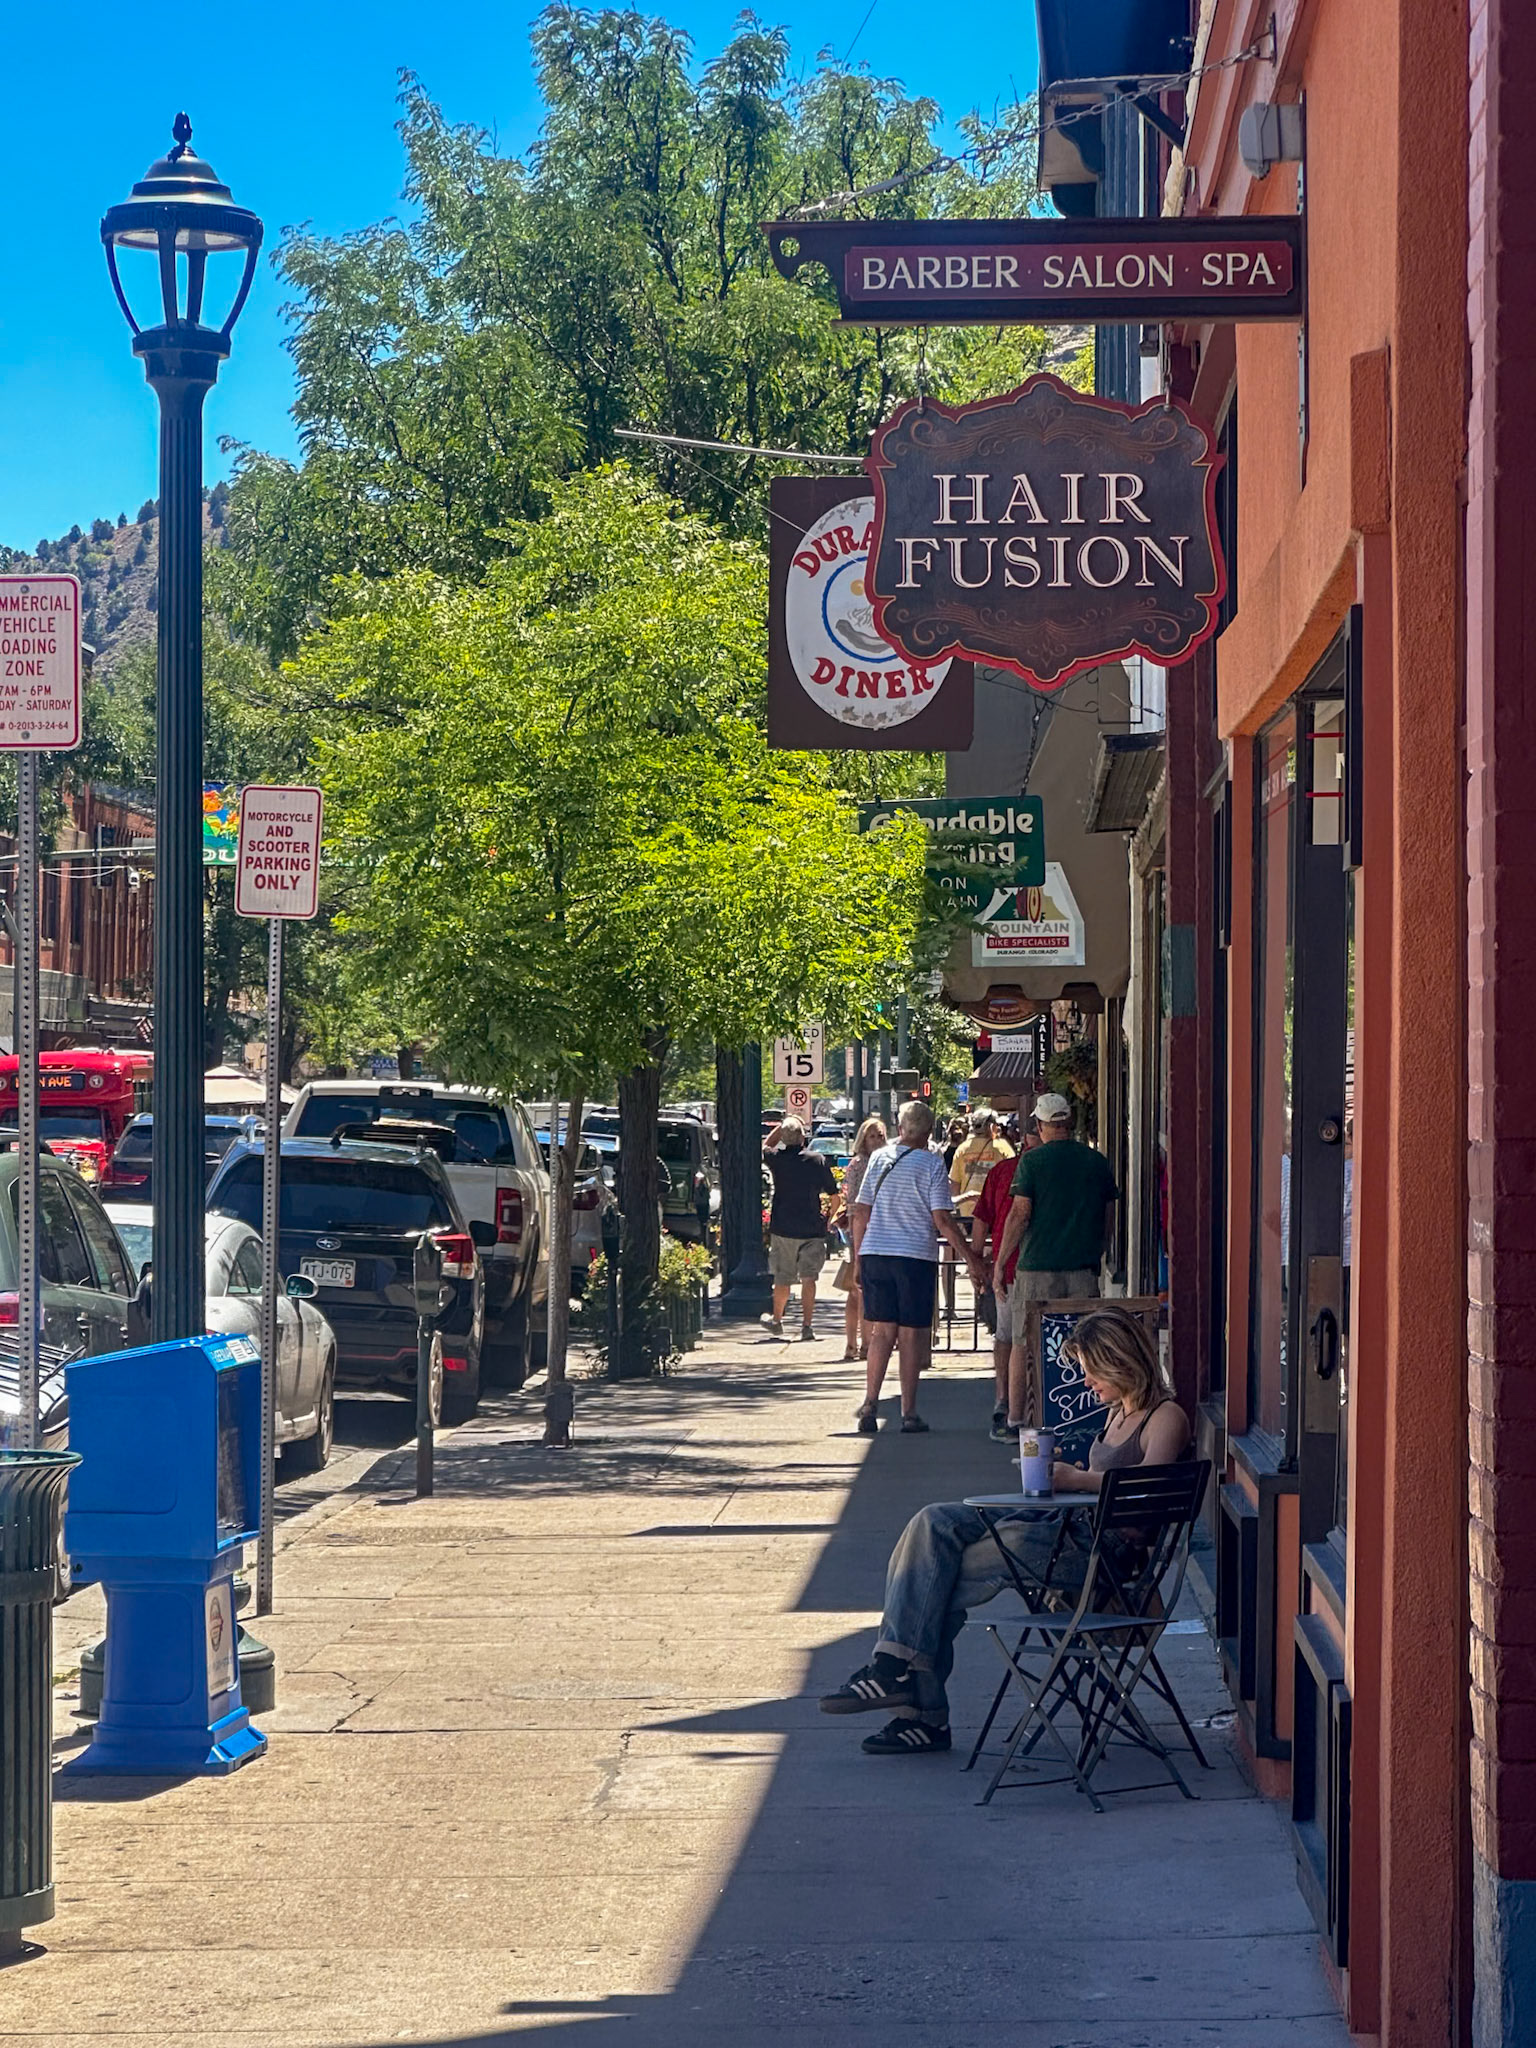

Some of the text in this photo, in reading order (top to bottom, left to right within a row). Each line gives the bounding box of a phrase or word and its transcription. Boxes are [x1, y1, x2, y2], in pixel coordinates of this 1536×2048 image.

[861, 251, 1277, 291] BARBER SALON SPA
[932, 472, 1152, 526] HAIR
[894, 535, 1190, 590] FUSION
[0, 616, 56, 634] EHICLE
[0, 638, 57, 655] OADING
[5, 660, 45, 677] ZONE
[809, 656, 935, 700] DINER
[30, 685, 52, 696] 6PM
[26, 699, 72, 711] SATURDAY
[247, 811, 314, 823] MOTORCYCLE
[265, 825, 294, 838] AND
[247, 839, 311, 854] SCOOTER
[244, 856, 312, 872] PARKING
[254, 873, 301, 891] ONLY
[940, 877, 968, 890] ON
[988, 937, 1068, 948] BIKE SPECIALISTS
[782, 1041, 815, 1051] LIMT
[785, 1054, 814, 1077] 15
[48, 1075, 72, 1088] AVE
